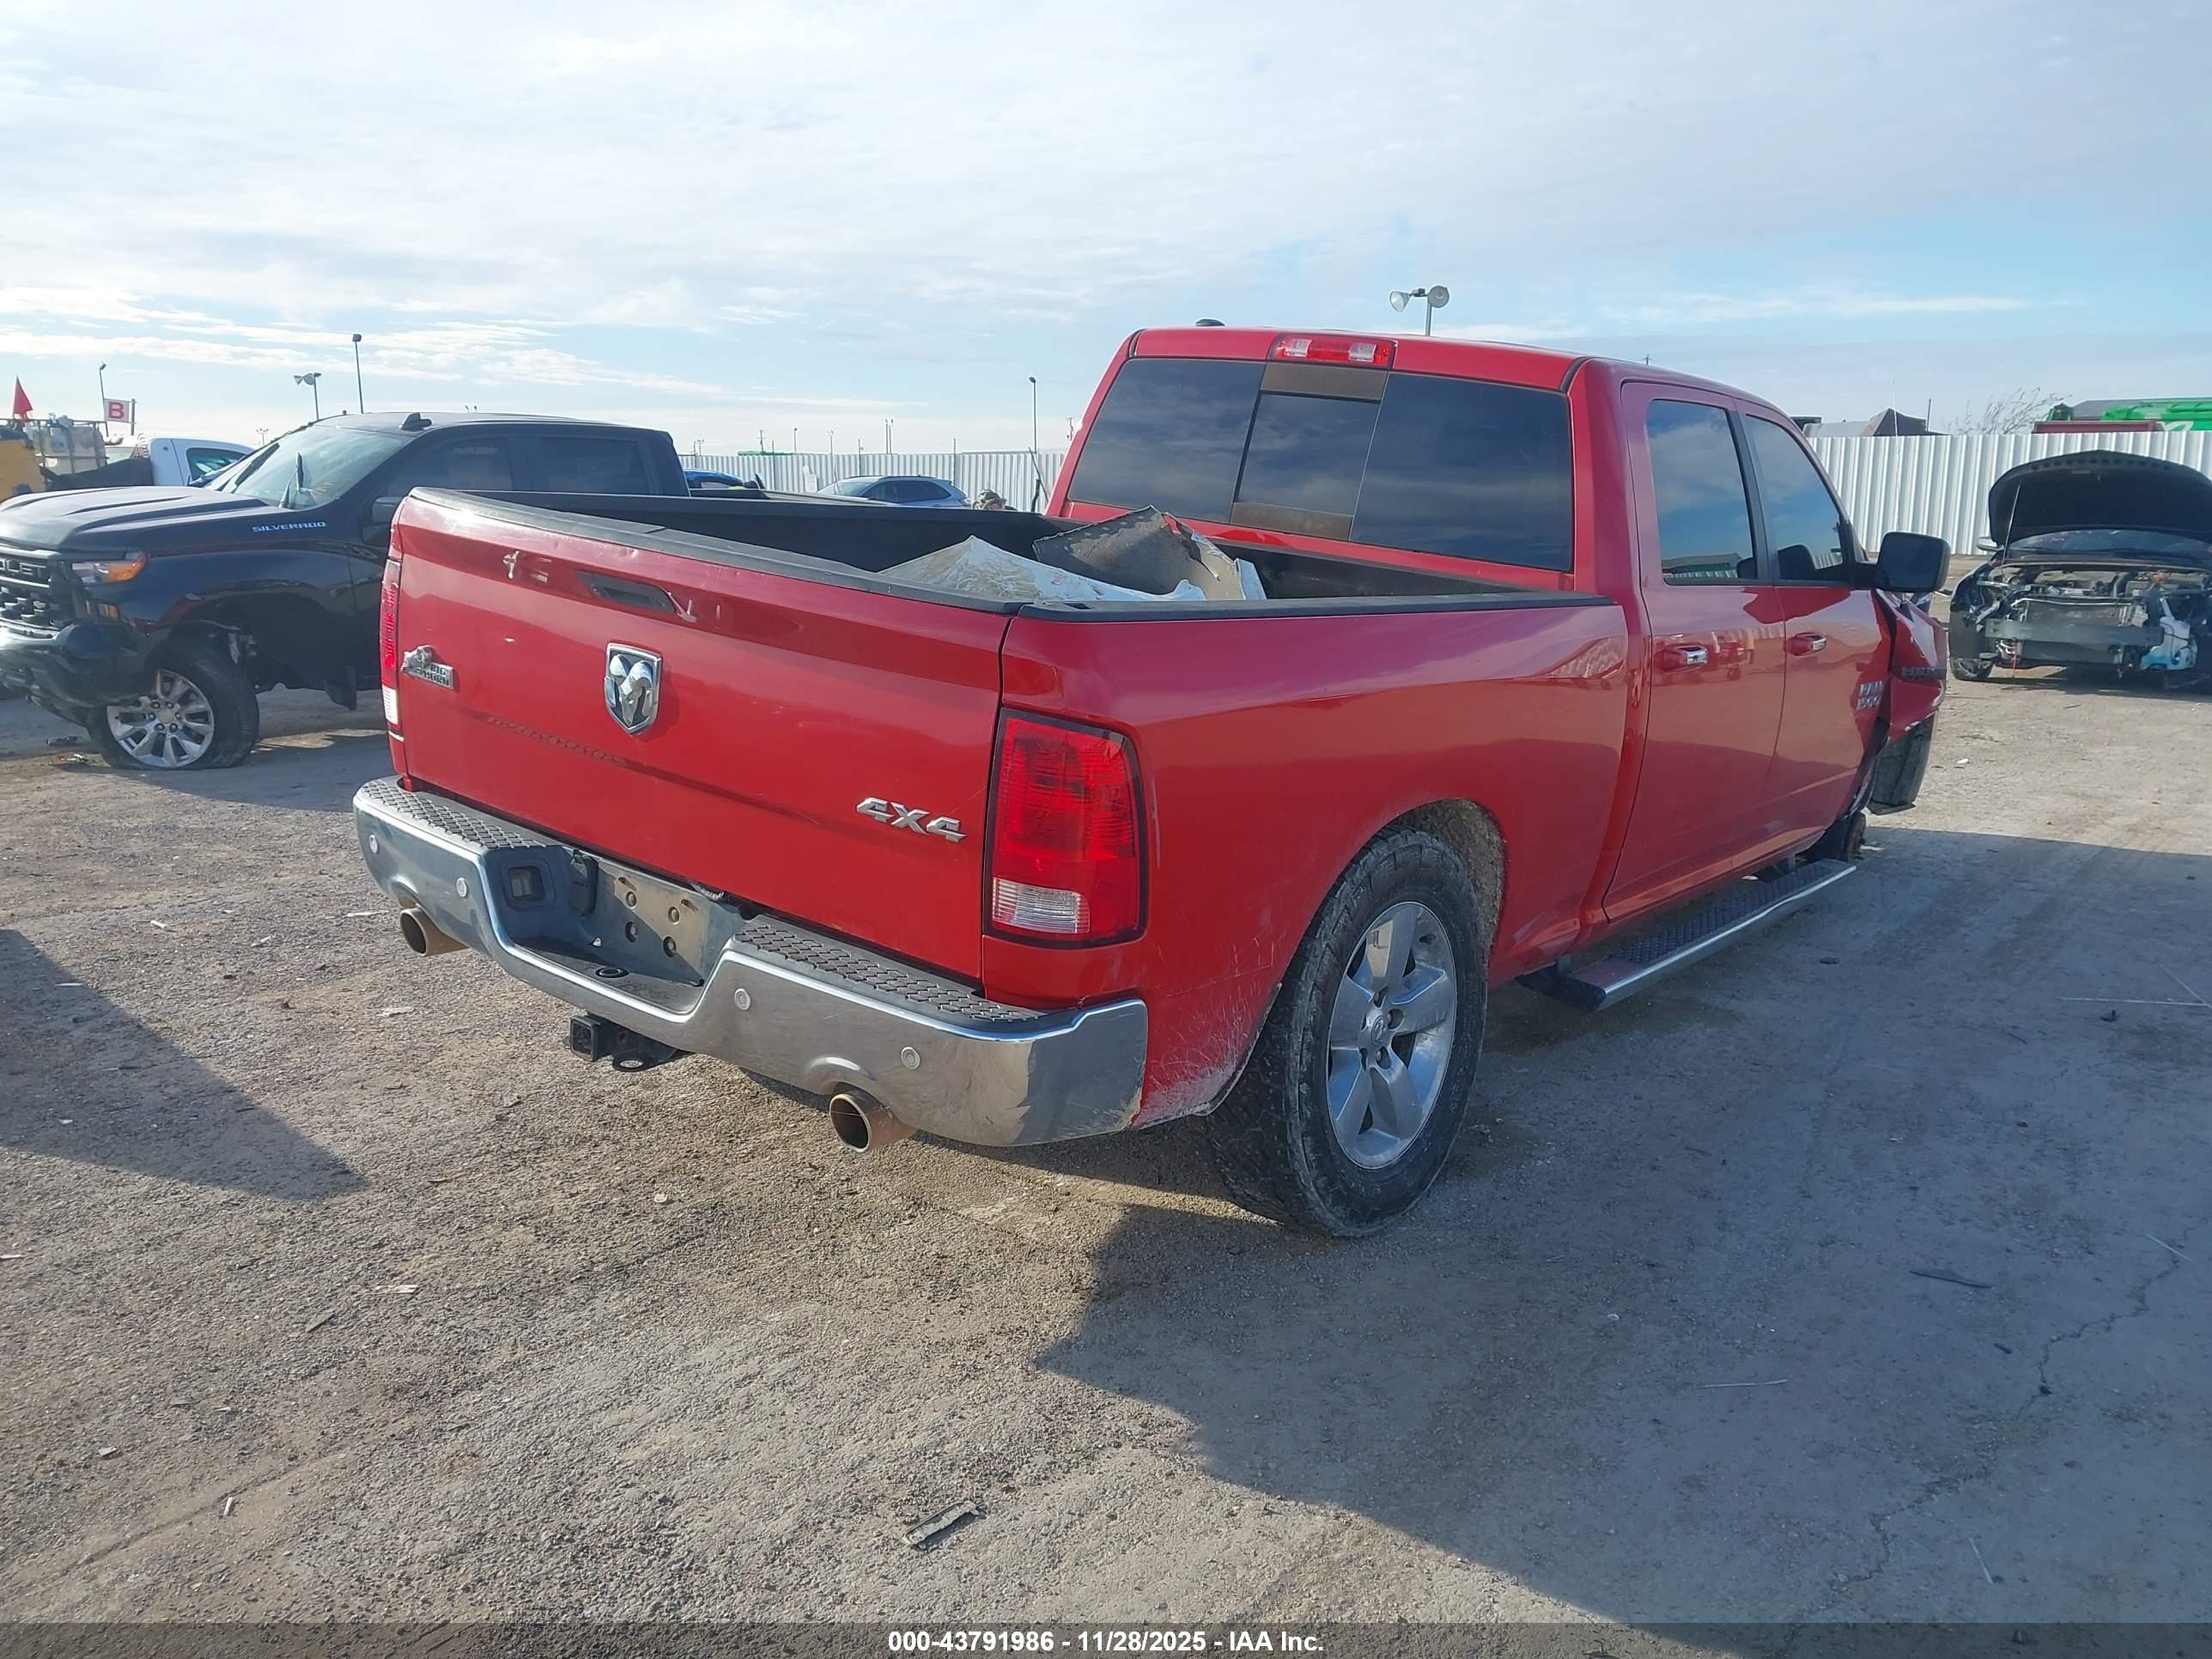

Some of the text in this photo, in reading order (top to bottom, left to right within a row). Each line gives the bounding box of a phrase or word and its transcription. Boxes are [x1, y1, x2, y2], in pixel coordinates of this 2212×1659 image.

[108, 401, 125, 419] B
[252, 520, 327, 532] SILVERADO
[856, 797, 969, 843] 4X4
